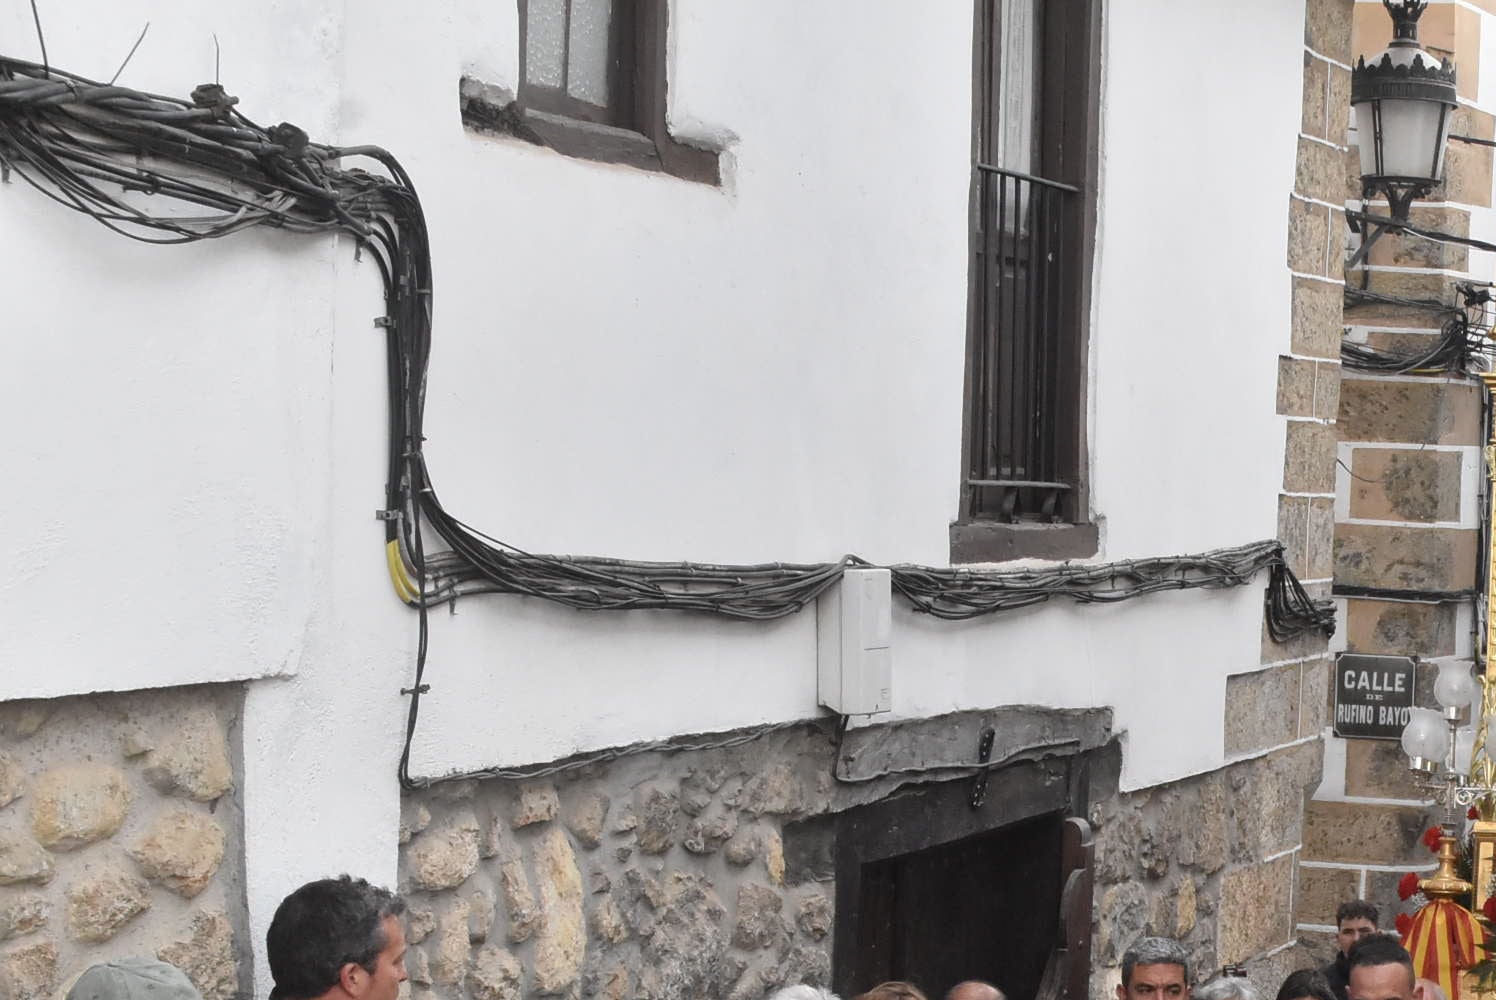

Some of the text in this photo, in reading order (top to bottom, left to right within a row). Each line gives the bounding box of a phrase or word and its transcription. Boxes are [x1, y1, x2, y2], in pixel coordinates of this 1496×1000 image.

[1344, 670, 1407, 692] CALLE
[1365, 693, 1384, 701] DE
[1337, 704, 1409, 727] RUFINO BAYO
